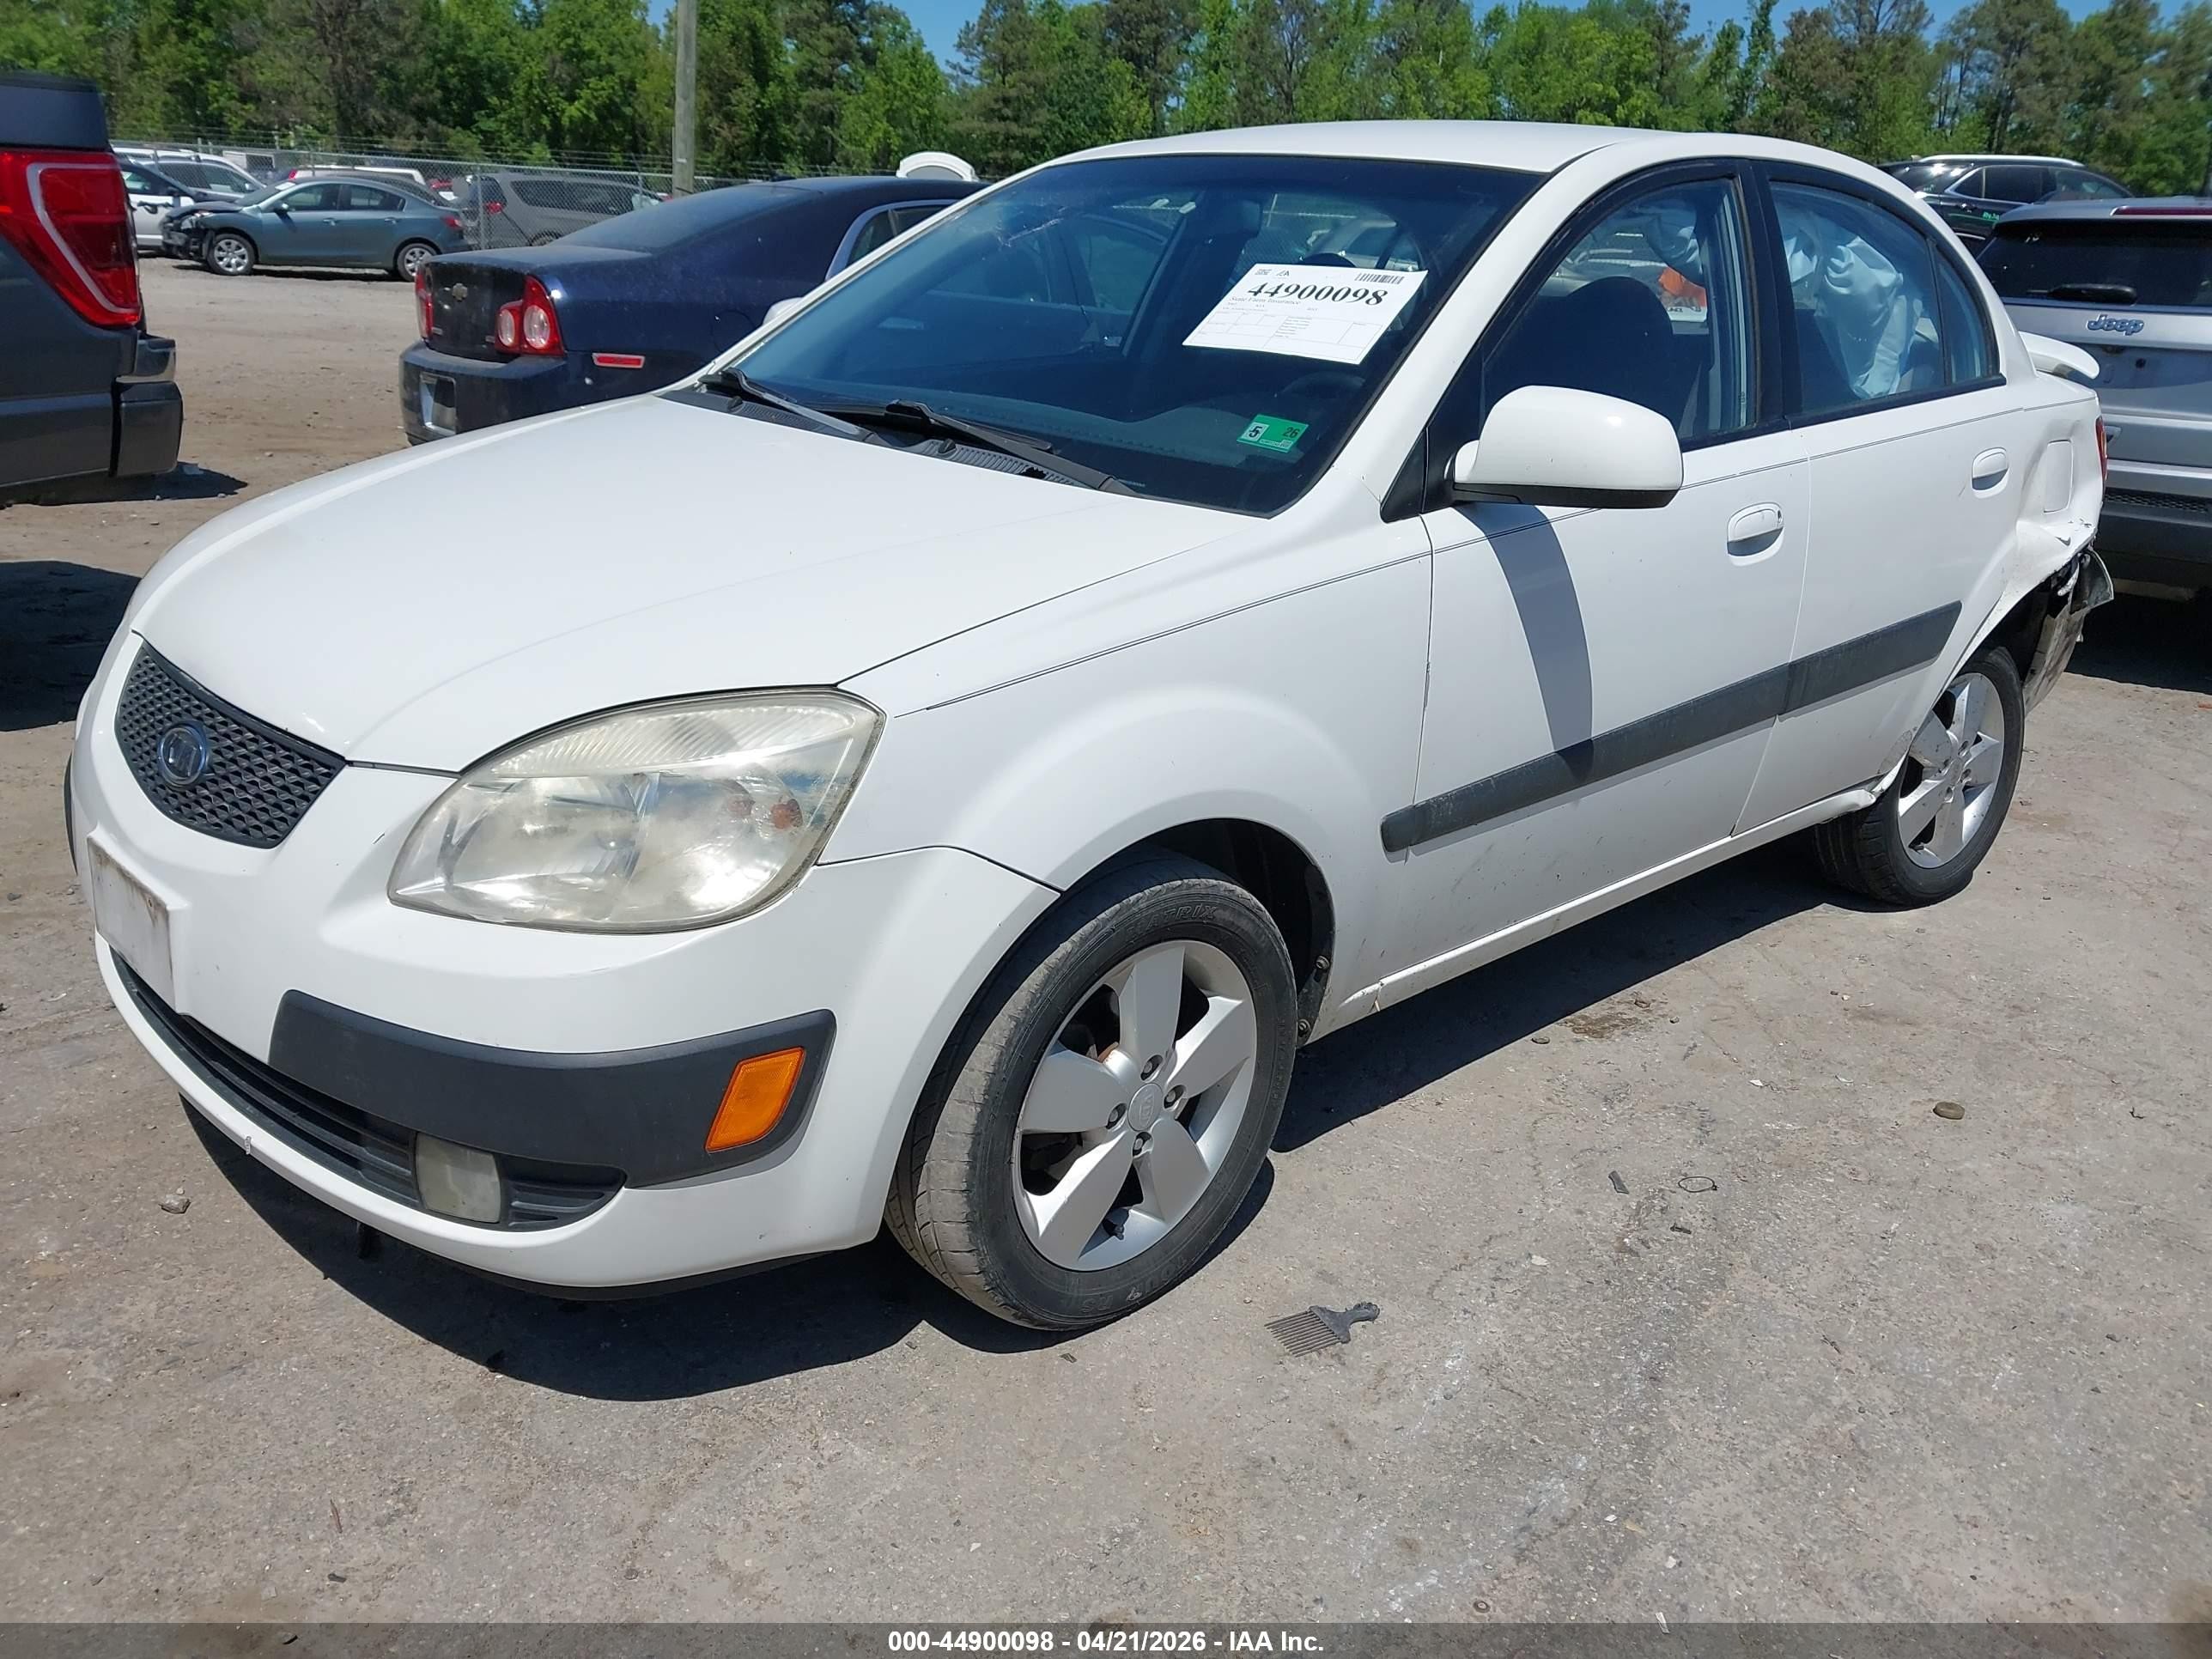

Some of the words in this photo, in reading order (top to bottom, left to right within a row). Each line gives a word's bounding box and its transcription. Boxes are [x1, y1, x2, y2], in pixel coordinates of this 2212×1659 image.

[1248, 282, 1389, 306] 44900098
[2086, 313, 2145, 336] Jeep
[1249, 426, 1263, 438] 5
[1283, 426, 1300, 439] 26
